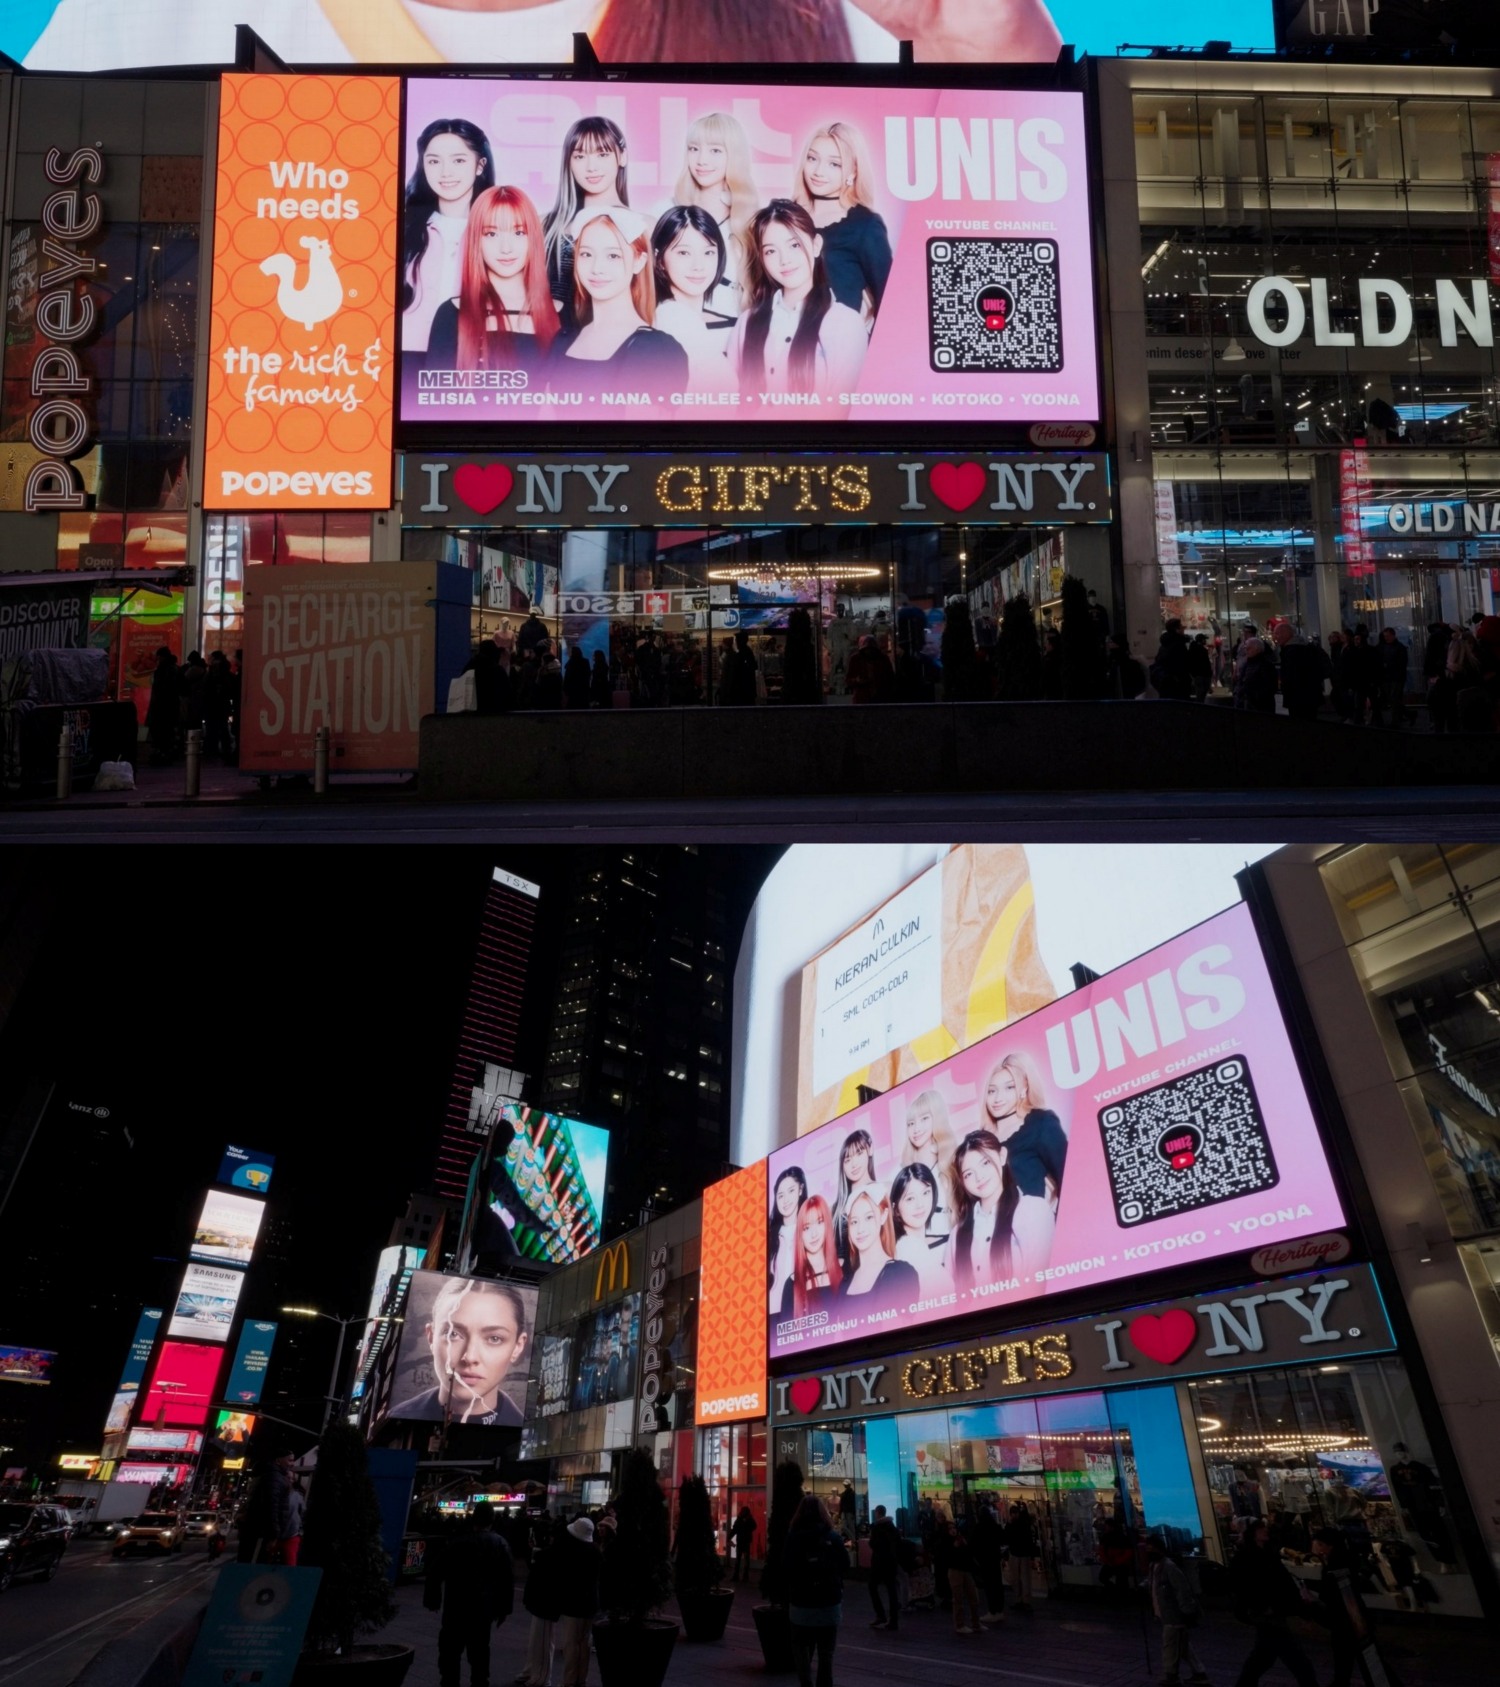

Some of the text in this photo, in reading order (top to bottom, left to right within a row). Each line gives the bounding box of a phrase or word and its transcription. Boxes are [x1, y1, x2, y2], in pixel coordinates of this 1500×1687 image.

[1308, 0, 1380, 36] GAP
[884, 116, 1069, 203] UNIS
[269, 162, 349, 190] Who
[257, 194, 359, 220] needs
[925, 219, 1058, 231] YOUTUBE CHANNEL
[1246, 275, 1413, 348] OLD
[224, 345, 281, 374] the
[289, 343, 358, 377] rich
[1175, 347, 1224, 359] deseres
[243, 374, 364, 413] famous
[418, 370, 528, 390] MEMBERS
[417, 393, 1080, 406] ELISIA HYEONJU NANA GEHLEE YUNHA SEOWON KOTOKO YOONA
[1035, 423, 1092, 446] Heritage
[420, 463, 448, 512] I
[655, 464, 872, 513] GIFTS
[898, 462, 925, 511] I
[1387, 503, 1455, 533] OLD
[84, 556, 114, 568] Open
[206, 534, 239, 629] OPEN
[0, 597, 80, 626] DISCOVER
[262, 590, 424, 656] RECHARGE
[260, 634, 422, 736] STATION
[504, 873, 530, 892] TSX
[834, 915, 921, 992] KIERAN CULKIN
[842, 970, 909, 1023] SML COCA-COLA
[1045, 943, 1247, 1090] UNIS
[1093, 1037, 1242, 1104] YOUTUBE CHANNEL
[226, 1151, 249, 1160] career
[228, 1145, 244, 1154] Your
[1259, 1238, 1343, 1270] Heritage
[193, 1268, 237, 1281] SAMSUNG
[776, 1203, 1313, 1347] ELISIA HYEONJU NANA GEHLEE YUNHA SEOWON KOTOKO YOONA
[776, 1311, 828, 1335] MEMBERS
[776, 1382, 792, 1417] I
[902, 1333, 1075, 1399] GIFTS
[1094, 1319, 1130, 1372] I
